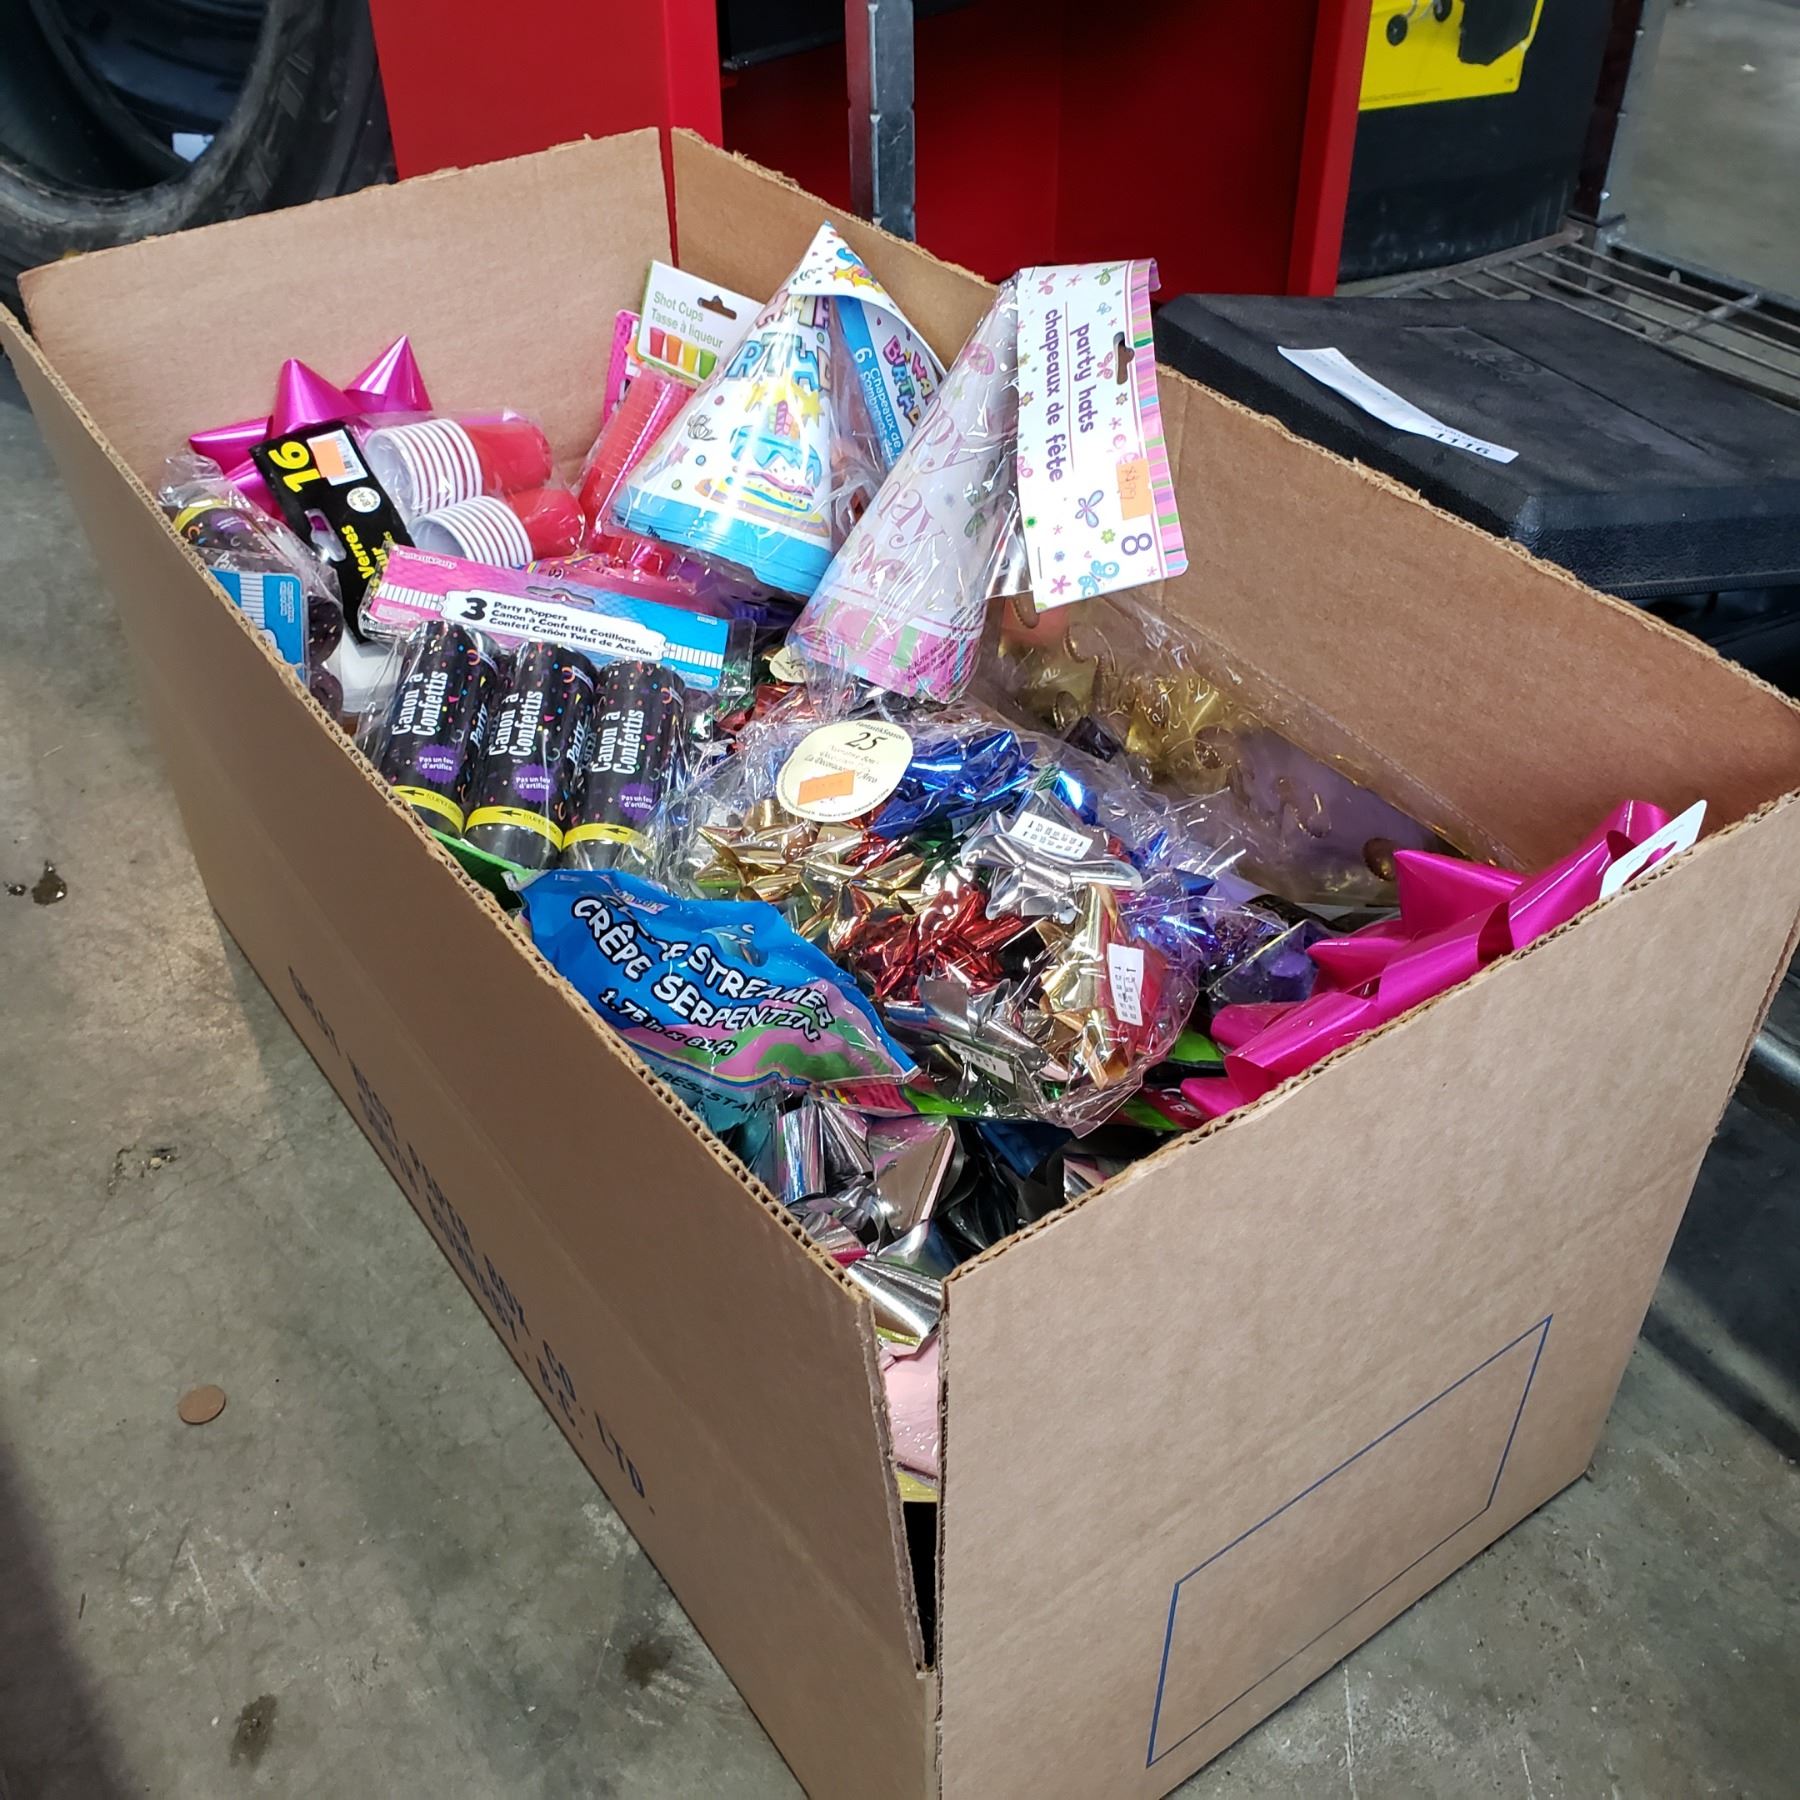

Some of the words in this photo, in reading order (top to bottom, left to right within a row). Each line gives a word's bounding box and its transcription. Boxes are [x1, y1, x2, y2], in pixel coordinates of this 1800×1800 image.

[651, 307, 679, 330] Tasse
[680, 319, 687, 334] à
[688, 323, 724, 349] liqueur
[653, 290, 677, 311] Shot
[678, 300, 705, 323] Cups
[854, 346, 873, 364] 6
[1038, 308, 1063, 398] chapeaux
[1069, 322, 1096, 383] party
[869, 367, 897, 431] Chapeaux
[1045, 401, 1065, 427] de
[1077, 383, 1099, 434] hats
[267, 440, 322, 494] 16
[1045, 433, 1067, 483] fête
[1435, 432, 1490, 455] 1116
[340, 524, 376, 580] Verres
[1121, 532, 1153, 556] 8
[460, 597, 488, 621] 3
[491, 609, 526, 623] Canon
[538, 617, 588, 636] Confettis
[589, 626, 637, 646] Cotillons
[493, 600, 522, 615] Party
[524, 606, 568, 624] Poppers
[489, 617, 530, 632] Confeti
[570, 632, 598, 646] Twist
[599, 638, 613, 648] de
[617, 643, 653, 657] Acción
[391, 688, 420, 736] Canon
[412, 670, 449, 737] Confettis
[470, 702, 489, 749] Party
[508, 690, 544, 758] Confettis
[488, 708, 516, 757] Canon
[566, 719, 587, 766] Party
[591, 726, 619, 774] Canon
[611, 708, 646, 776] Confettis
[844, 731, 889, 752] 25
[418, 755, 434, 765] Pas
[515, 775, 530, 784] Pas
[573, 897, 654, 981] CRÊPE
[651, 973, 822, 1043] SERPENTIN
[687, 944, 836, 1029] STREAMER
[600, 989, 648, 1025] 1.75
[645, 1018, 665, 1034] in
[666, 1029, 685, 1042] x
[483, 1252, 532, 1339] BOX
[594, 1409, 656, 1517] LTD.
